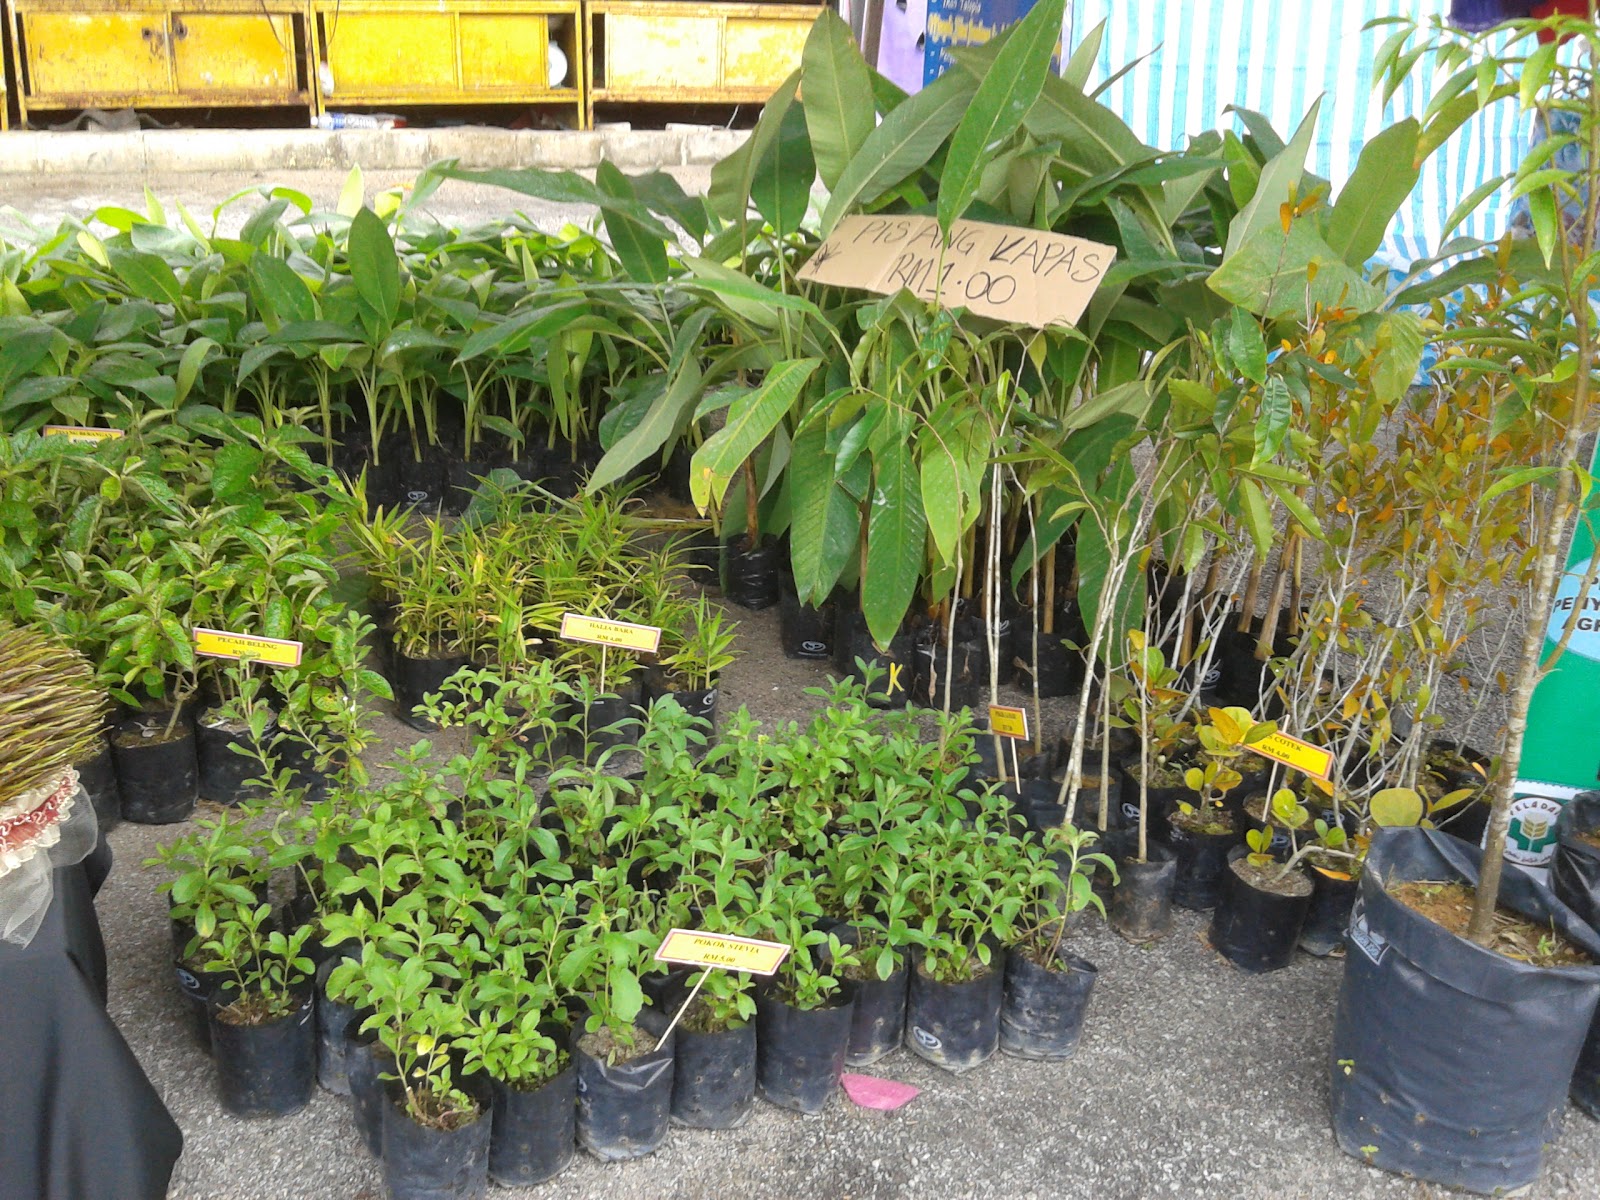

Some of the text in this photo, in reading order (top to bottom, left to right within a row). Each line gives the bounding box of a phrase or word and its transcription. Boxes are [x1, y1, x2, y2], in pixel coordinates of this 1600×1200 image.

[853, 219, 1100, 283] PISANG KAPAS
[217, 636, 278, 649] PECAH BELING
[1262, 744, 1290, 760] RM 4.00
[1274, 736, 1302, 752] COTEK
[694, 938, 760, 954] POKOK STEVIA
